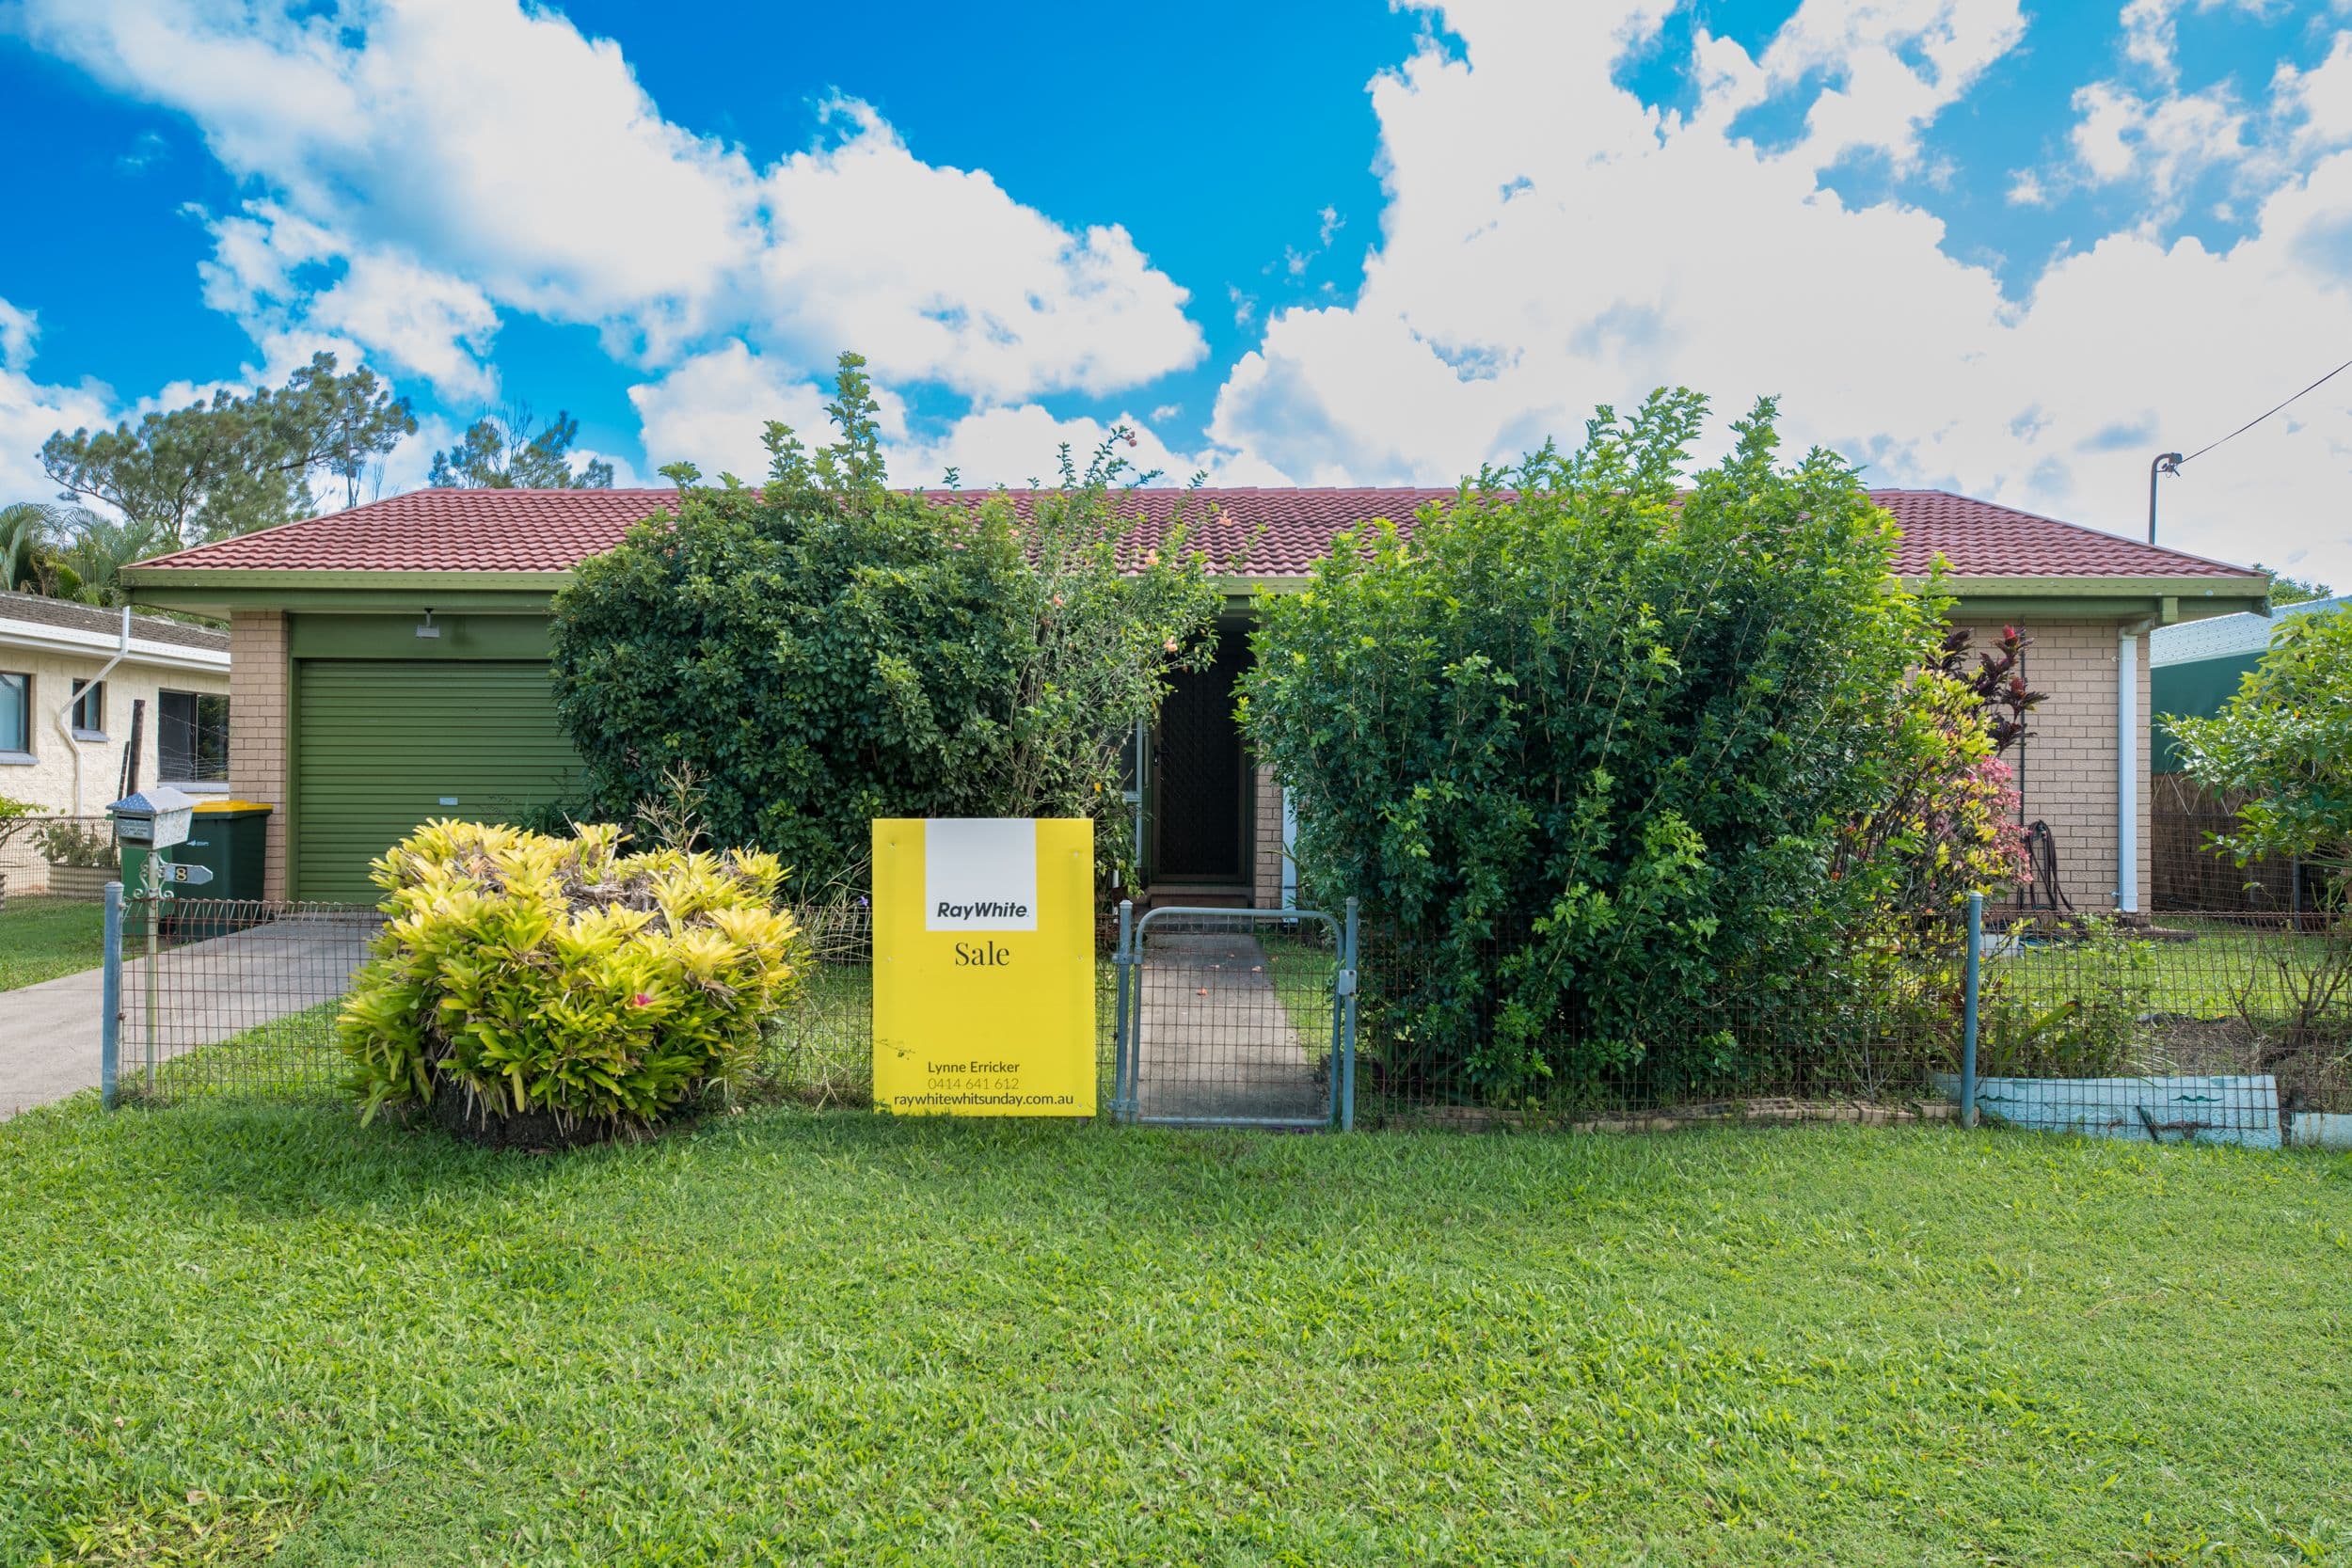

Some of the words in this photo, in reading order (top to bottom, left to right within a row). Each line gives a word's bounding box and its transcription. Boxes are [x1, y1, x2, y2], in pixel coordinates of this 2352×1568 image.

[176, 867, 187, 880] 8
[955, 941, 1009, 966] Sale
[928, 1061, 966, 1075] Lynne
[970, 1061, 1020, 1073] Erricker
[928, 1078, 961, 1090] 0414
[965, 1078, 991, 1090] 641
[994, 1078, 1019, 1090] 612
[894, 1092, 1073, 1107] raywhitewhitsunday.com.au
